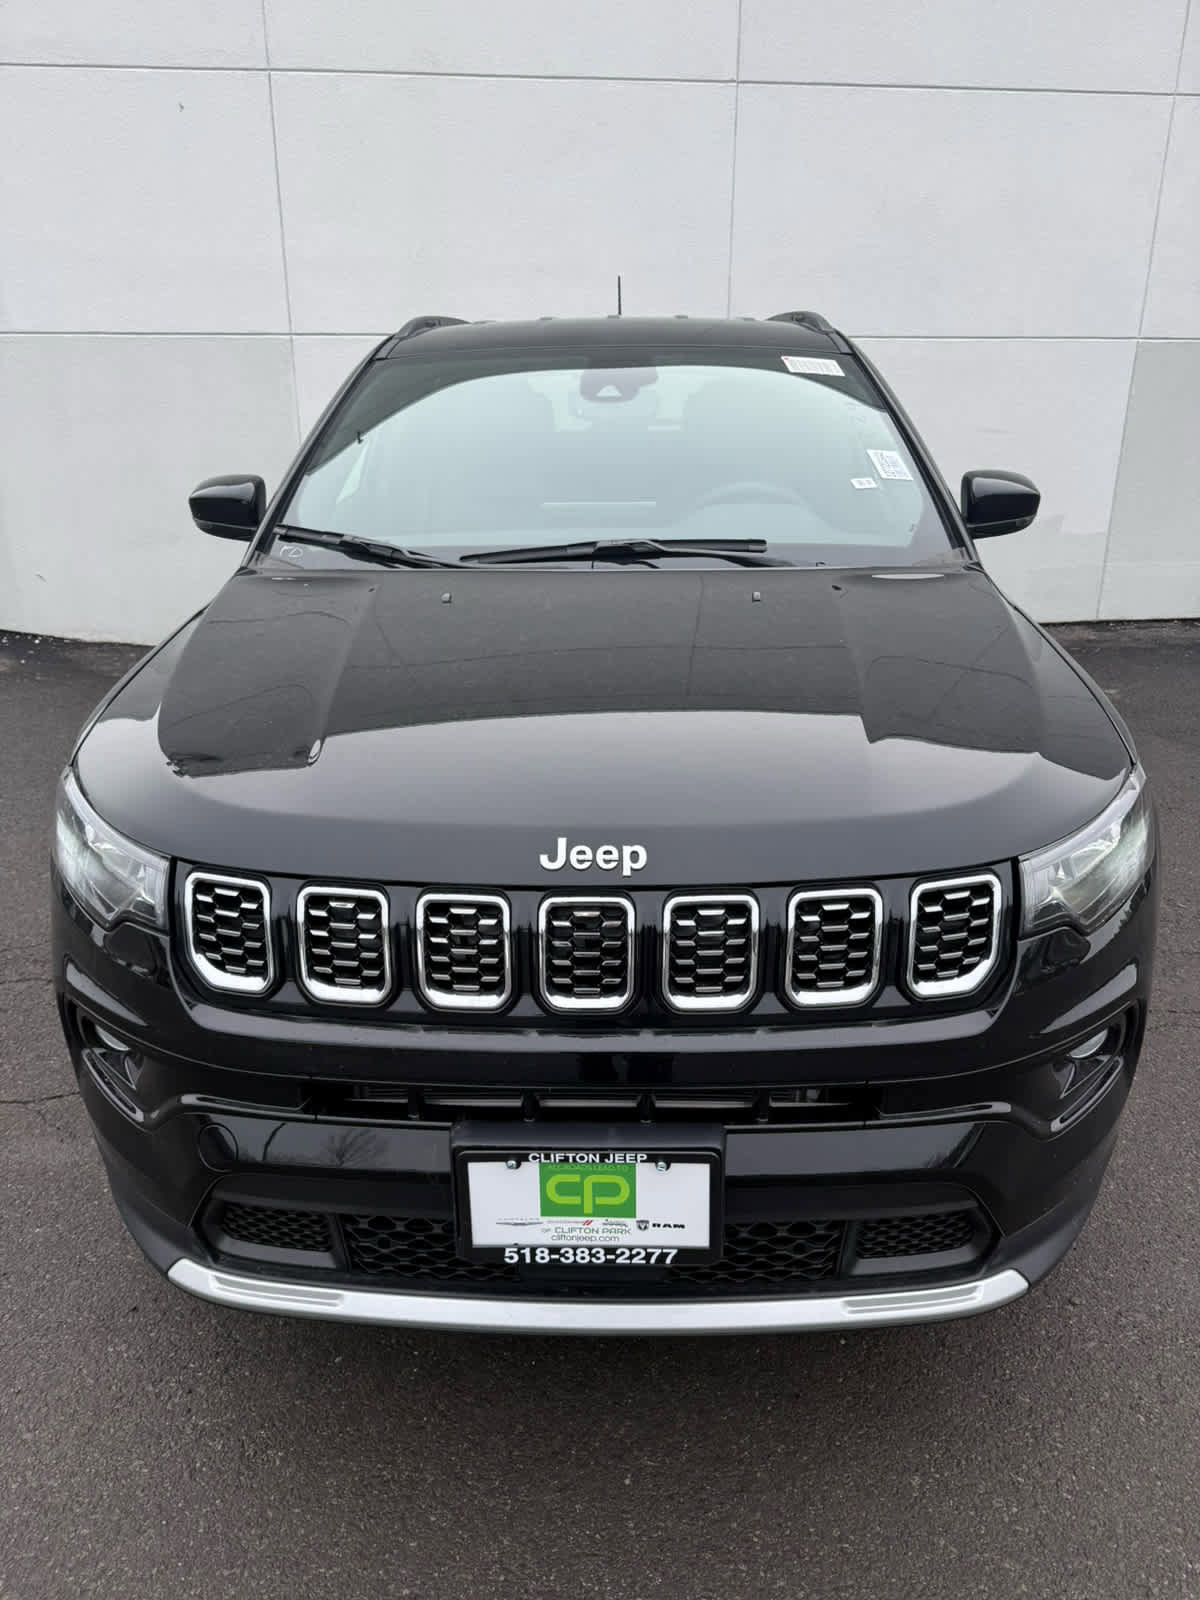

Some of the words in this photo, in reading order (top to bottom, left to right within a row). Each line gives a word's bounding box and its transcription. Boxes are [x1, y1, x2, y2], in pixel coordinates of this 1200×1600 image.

[539, 837, 648, 877] Jeep
[528, 1152, 600, 1164] CLIFTON
[604, 1153, 648, 1164] JEEP
[554, 1226, 599, 1234] CLIFTON
[602, 1227, 631, 1235] PARK
[551, 1233, 620, 1242] cliftonjeep.com
[503, 1247, 678, 1265] 518-383-2277
